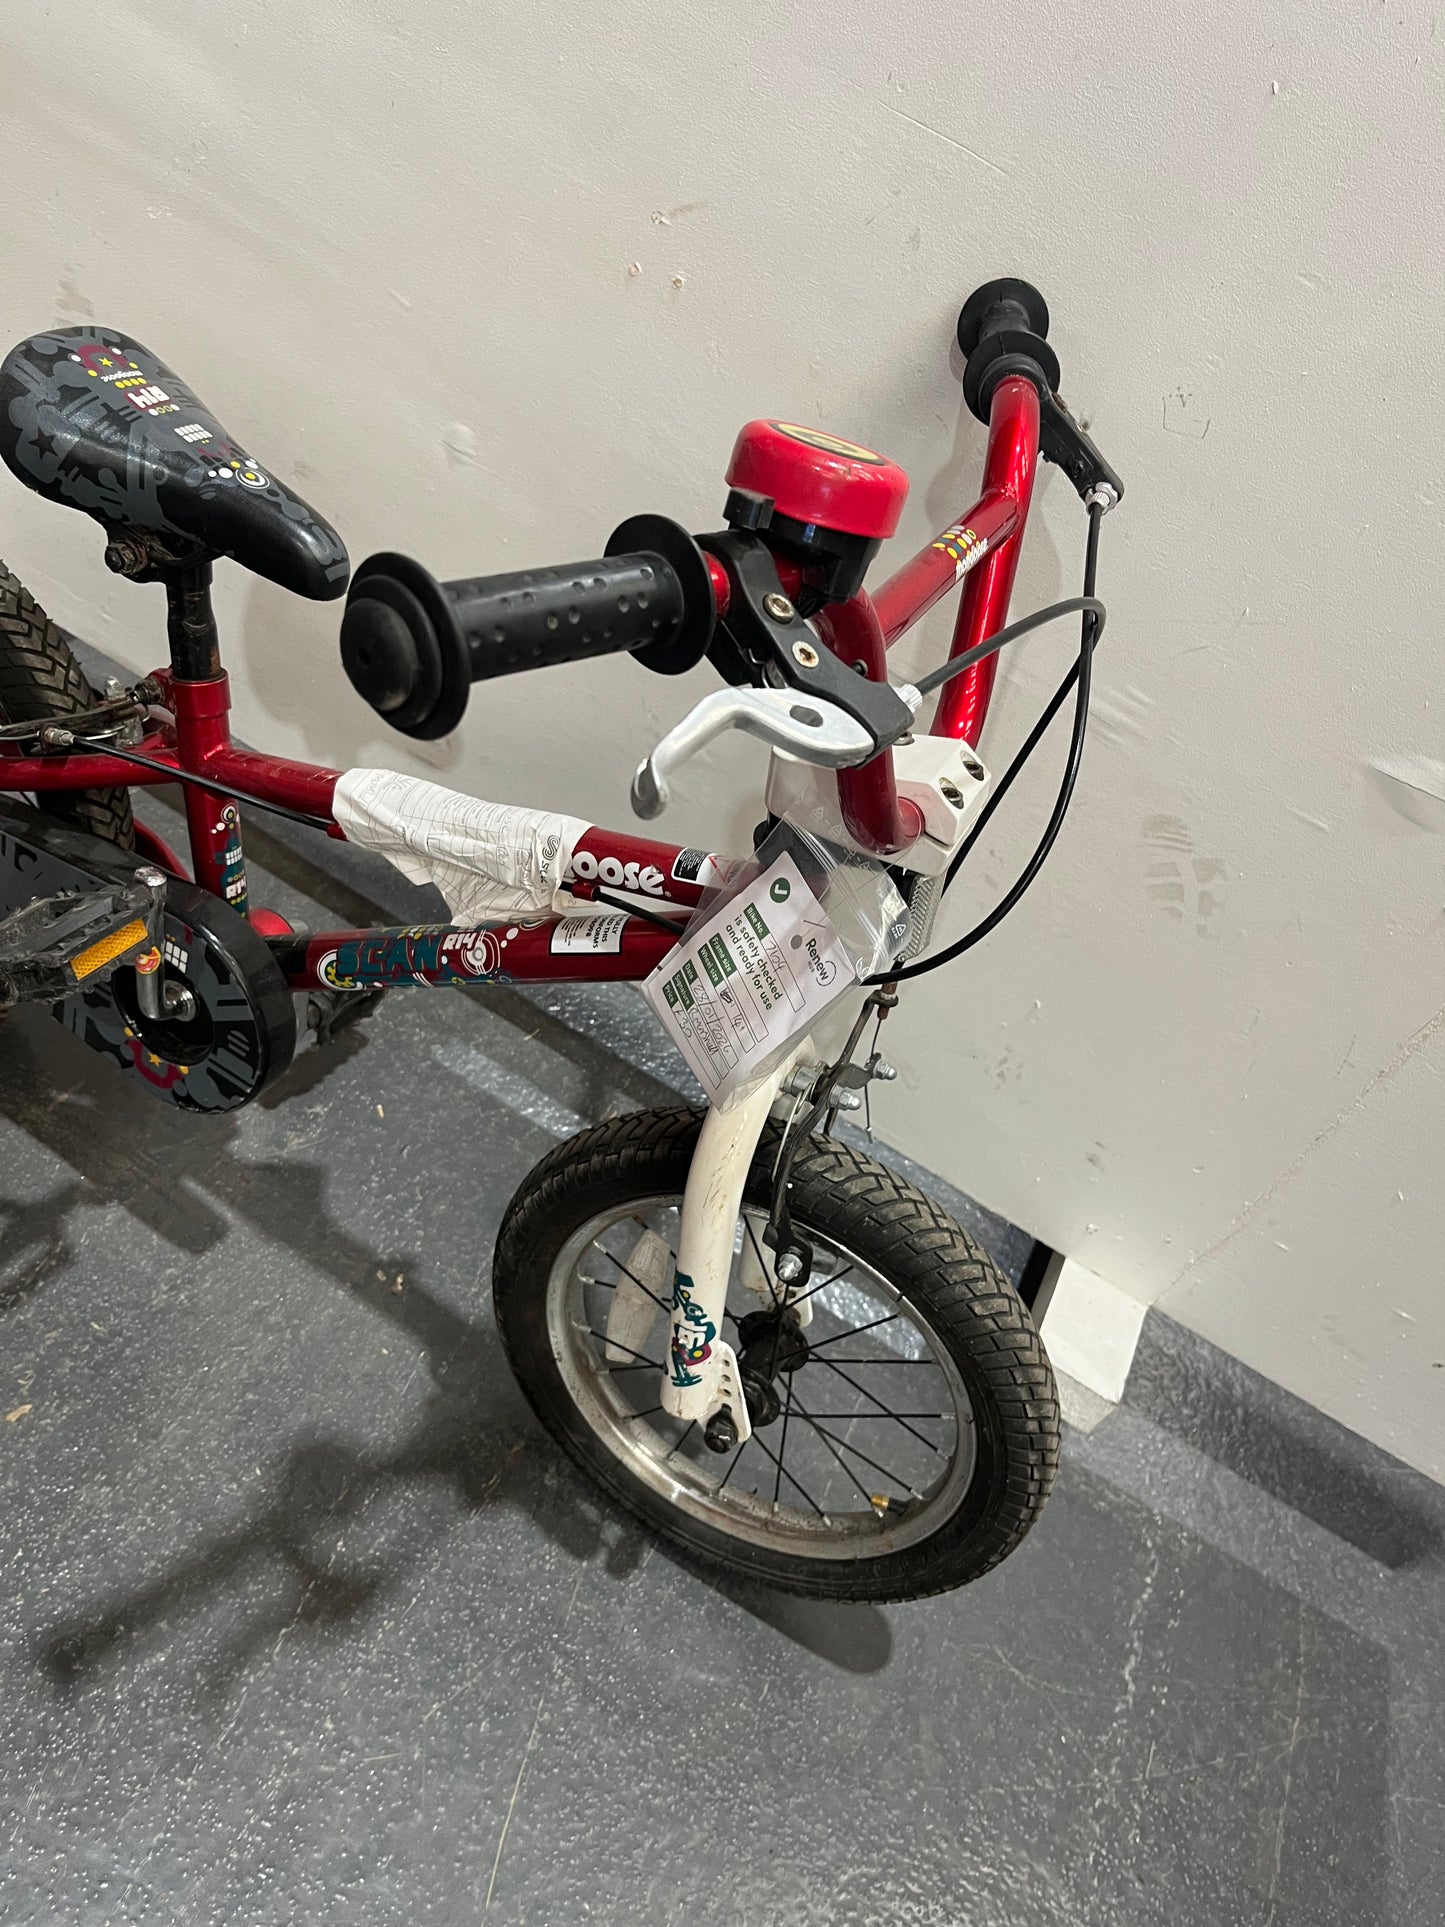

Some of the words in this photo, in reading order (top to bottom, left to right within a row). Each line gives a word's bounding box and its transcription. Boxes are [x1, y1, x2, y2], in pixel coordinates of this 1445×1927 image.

[564, 851, 665, 895] oose
[601, 926, 610, 943] THIS
[746, 906, 757, 923] Bike
[754, 920, 764, 935] No.
[337, 937, 443, 976] SCAN
[684, 963, 693, 979] Date
[699, 946, 713, 969] Wheel
[709, 967, 718, 982] size
[711, 935, 725, 959] Frame
[722, 957, 731, 972] size
[725, 923, 741, 944] and
[736, 944, 755, 973] ready
[752, 973, 763, 991] for
[759, 991, 771, 1010] use
[733, 913, 743, 926] is
[739, 926, 760, 957] safety
[756, 957, 782, 1000] checked
[804, 937, 829, 980] Renew
[663, 984, 674, 1002] Price
[673, 973, 690, 1004] Signature
